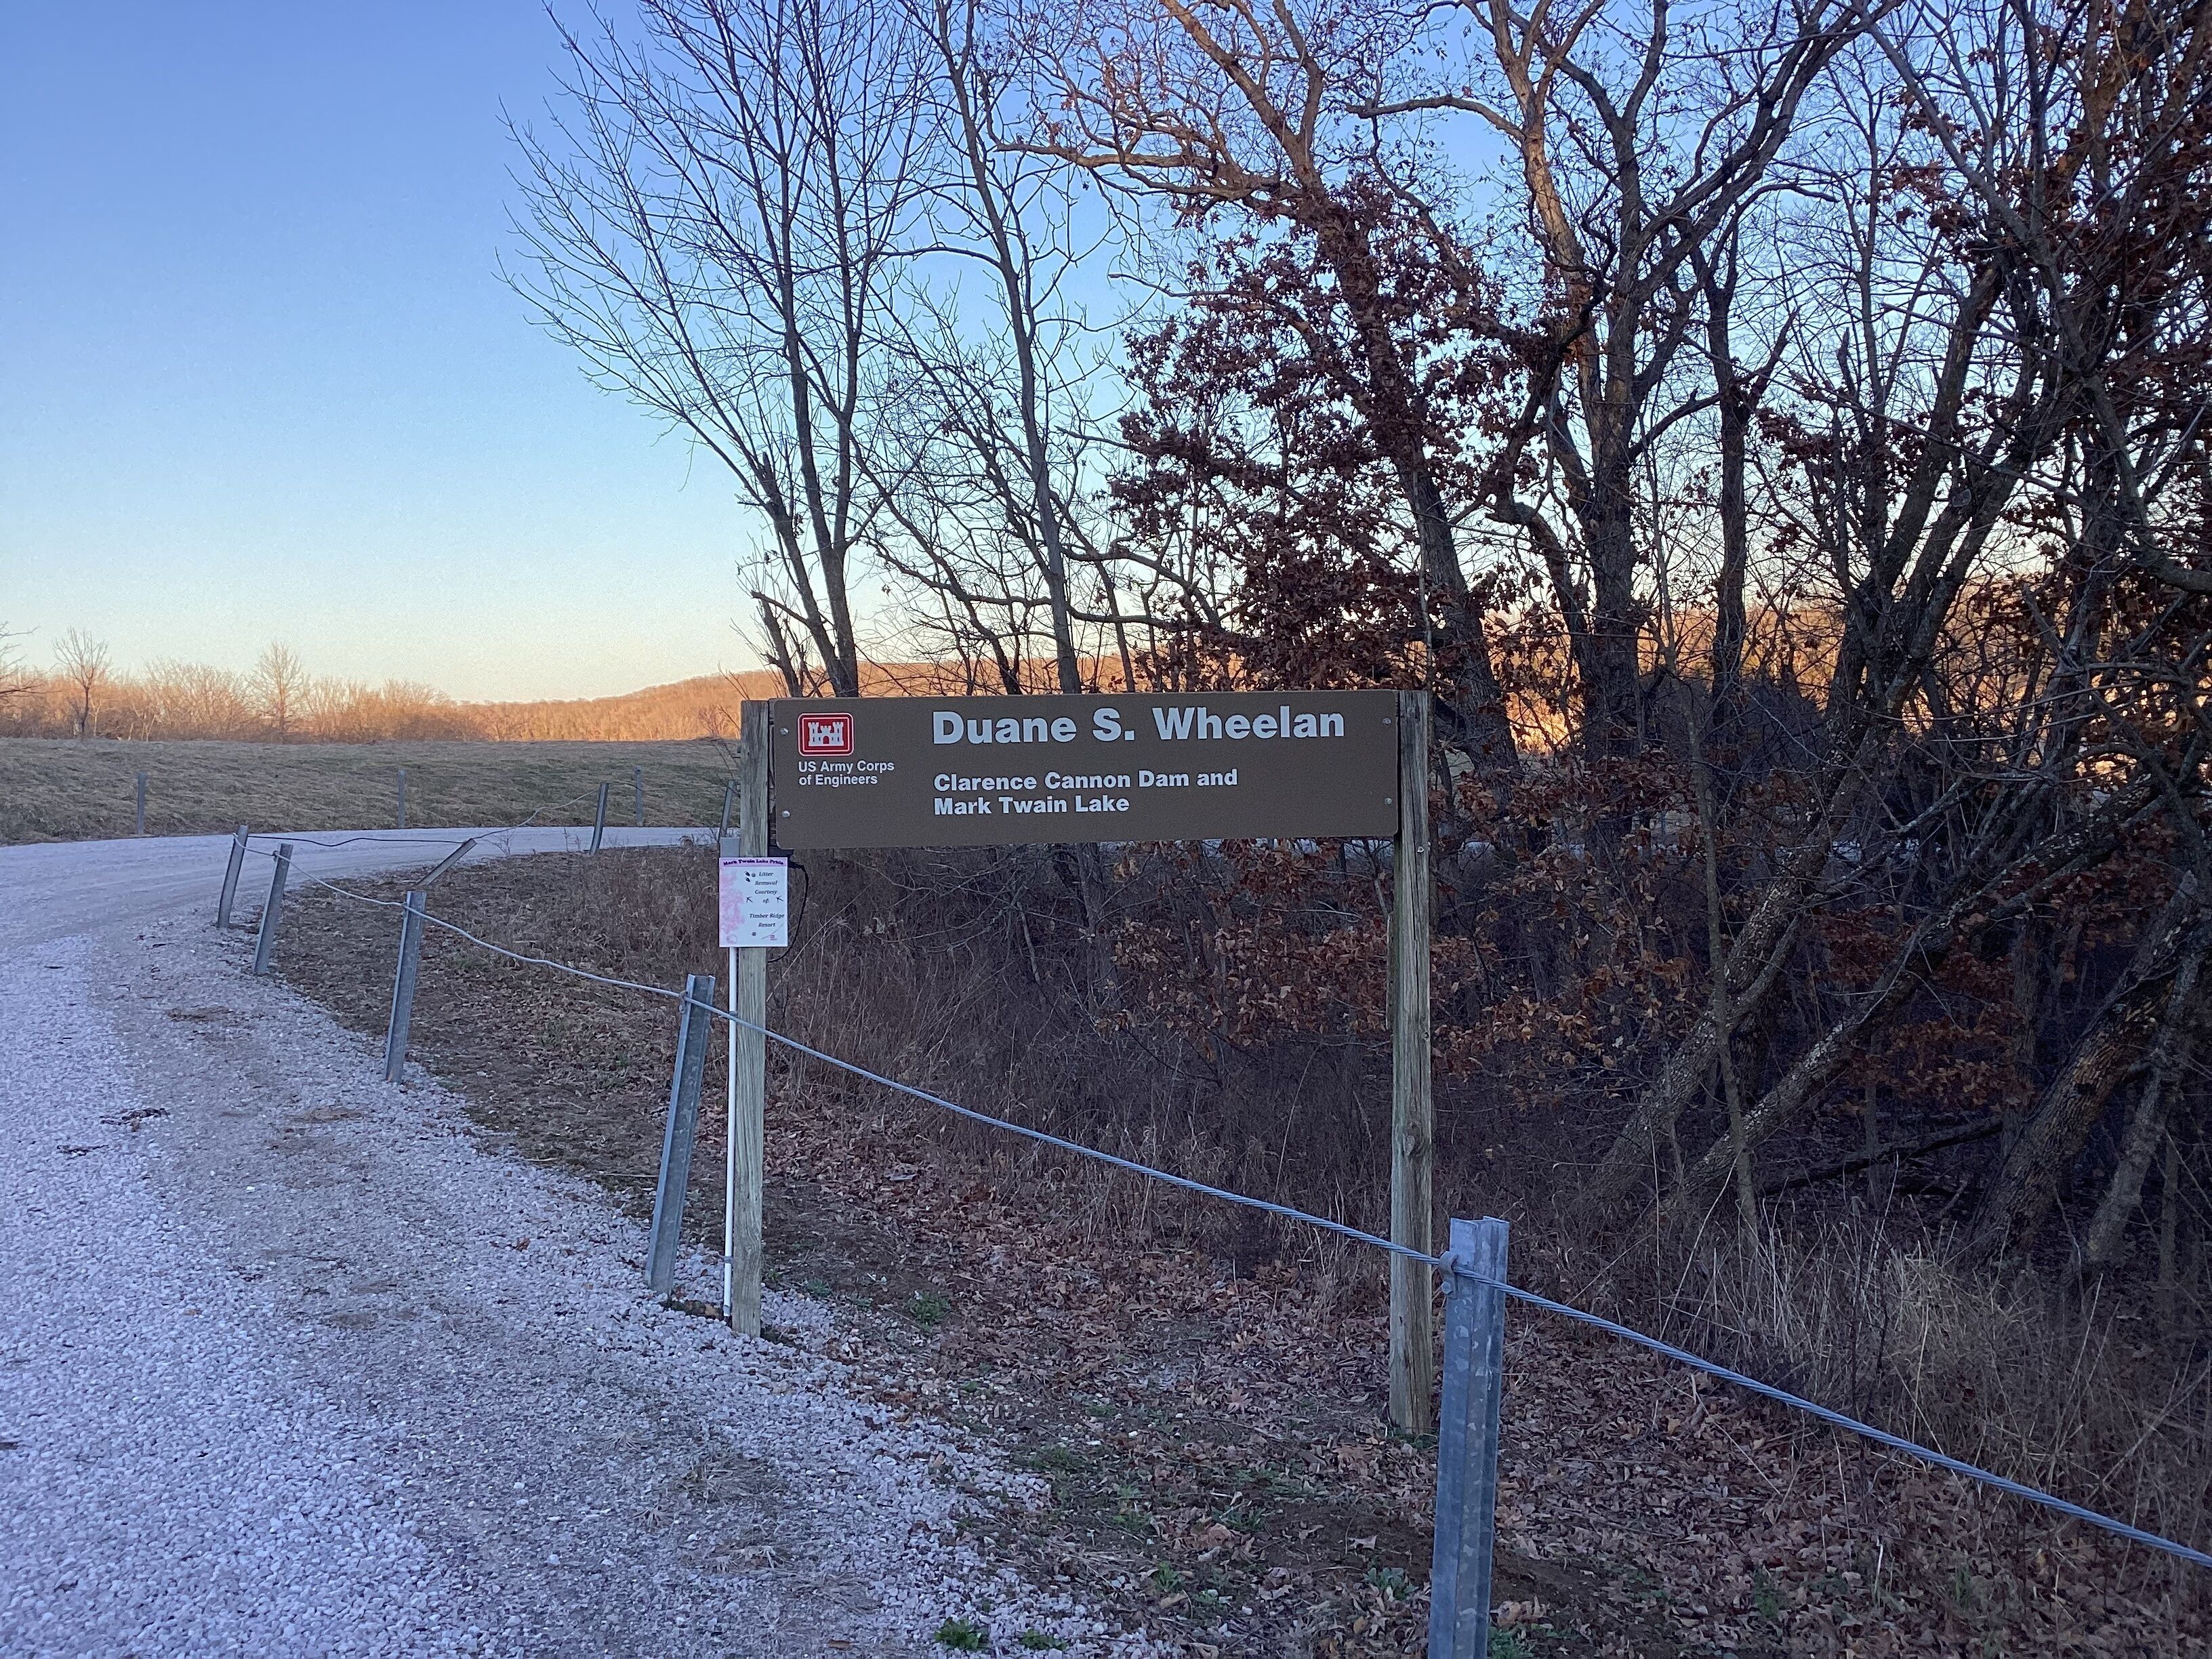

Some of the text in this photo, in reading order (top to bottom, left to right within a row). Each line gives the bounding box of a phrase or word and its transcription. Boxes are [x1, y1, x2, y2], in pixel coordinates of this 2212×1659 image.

[933, 705, 1345, 744] Duane S. Wheelan
[798, 760, 895, 774] US Army Corps
[798, 773, 878, 788] of Engineers
[934, 769, 1237, 792] Clarence Cannon Dam and
[934, 794, 1130, 815] Mark Twain Lake
